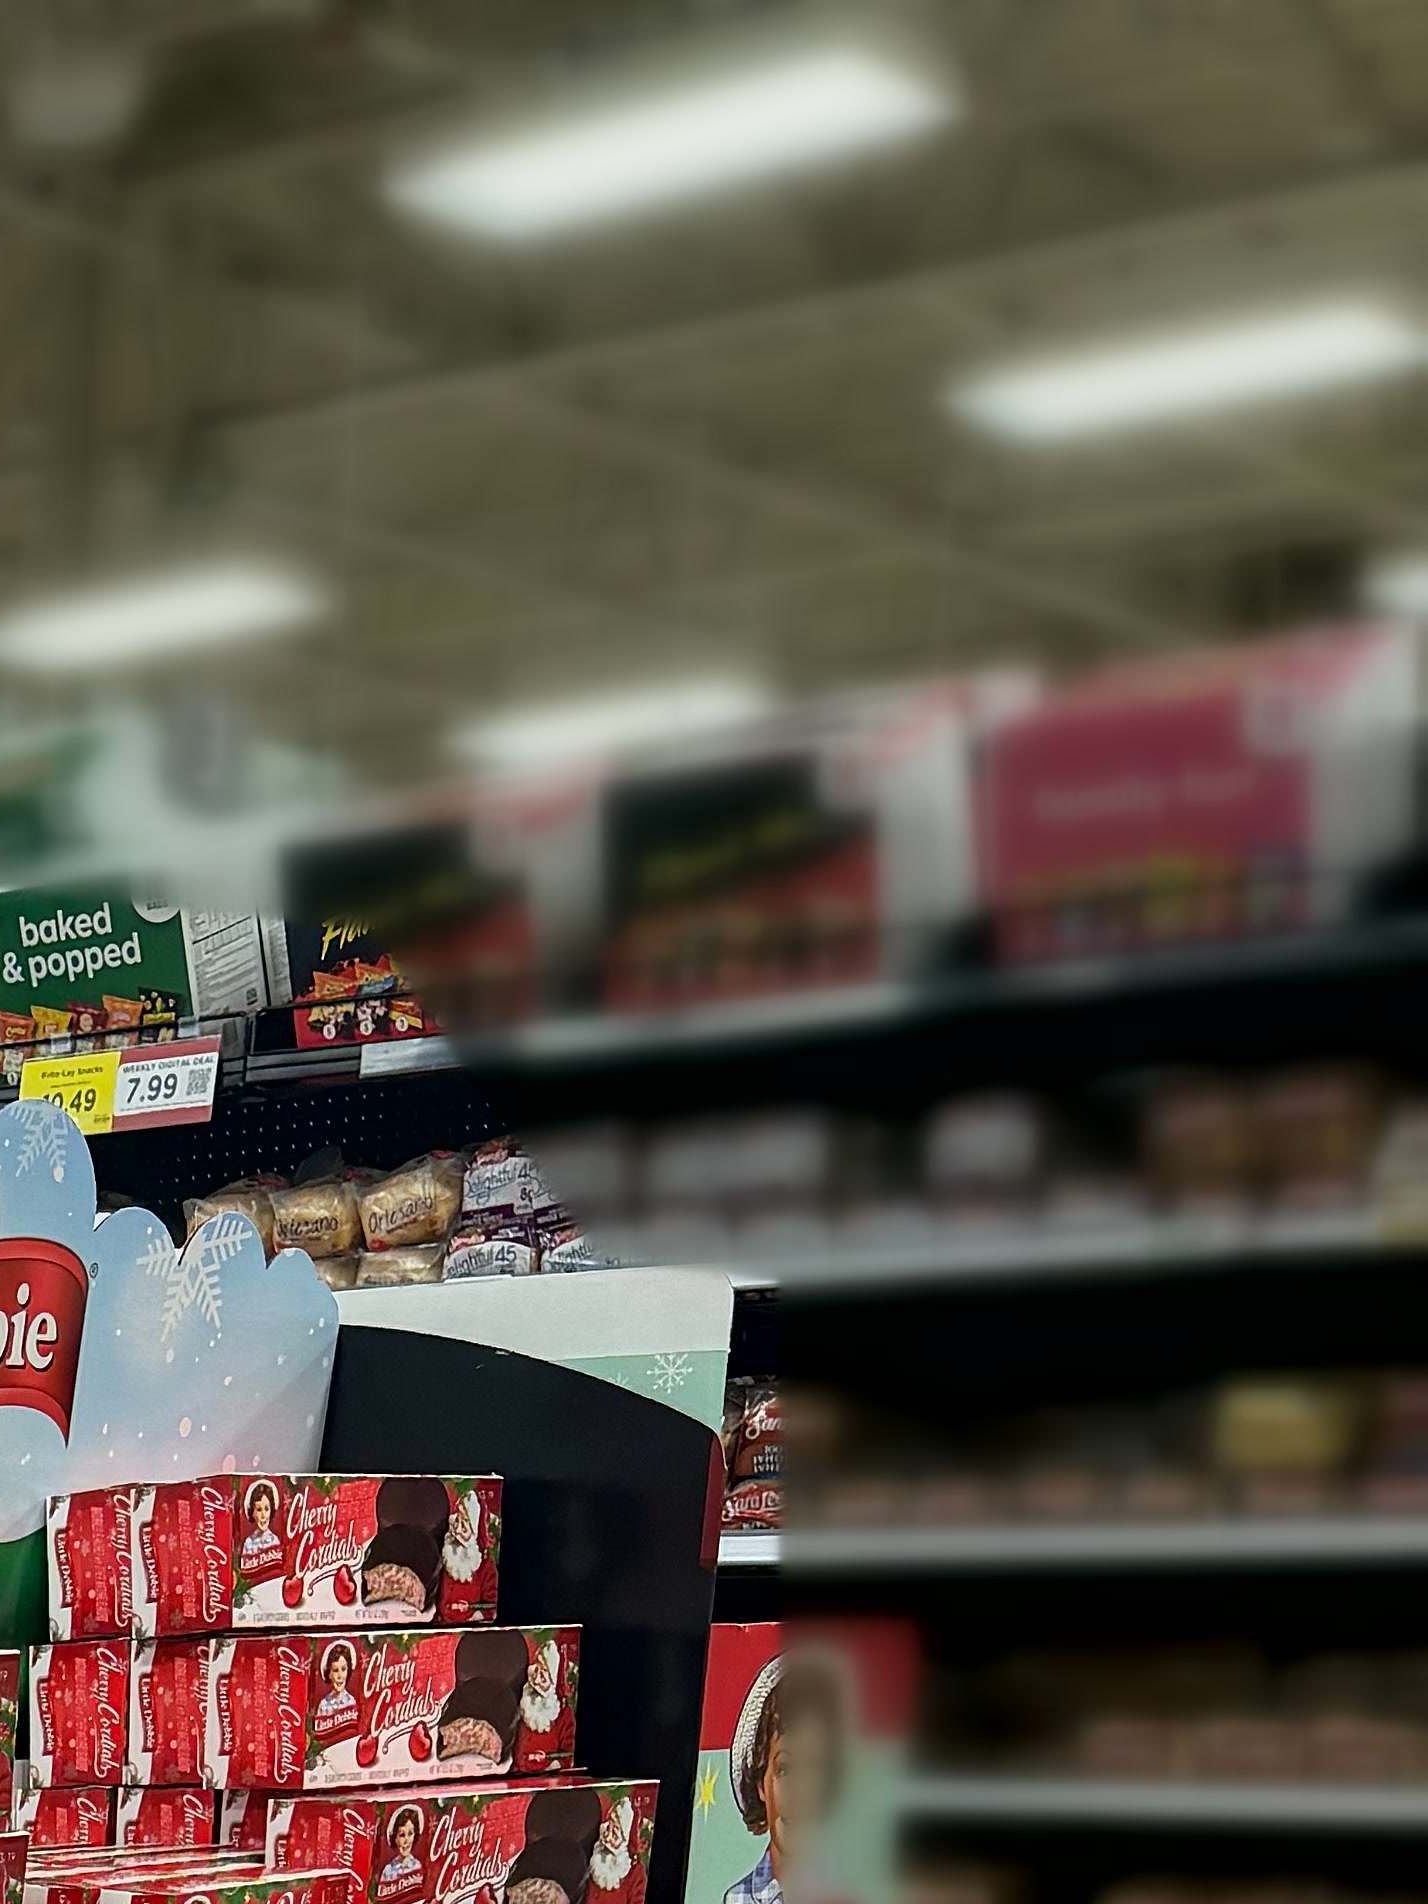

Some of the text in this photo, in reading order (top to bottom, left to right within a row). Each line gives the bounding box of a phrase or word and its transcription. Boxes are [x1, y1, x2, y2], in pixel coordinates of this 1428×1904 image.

[19, 902, 113, 948] baked
[2, 932, 142, 988] & popped
[193, 1056, 215, 1065] DEAL
[126, 1073, 178, 1104] 7.99
[363, 1642, 415, 1699] Cherry
[371, 1683, 443, 1738] Cordials
